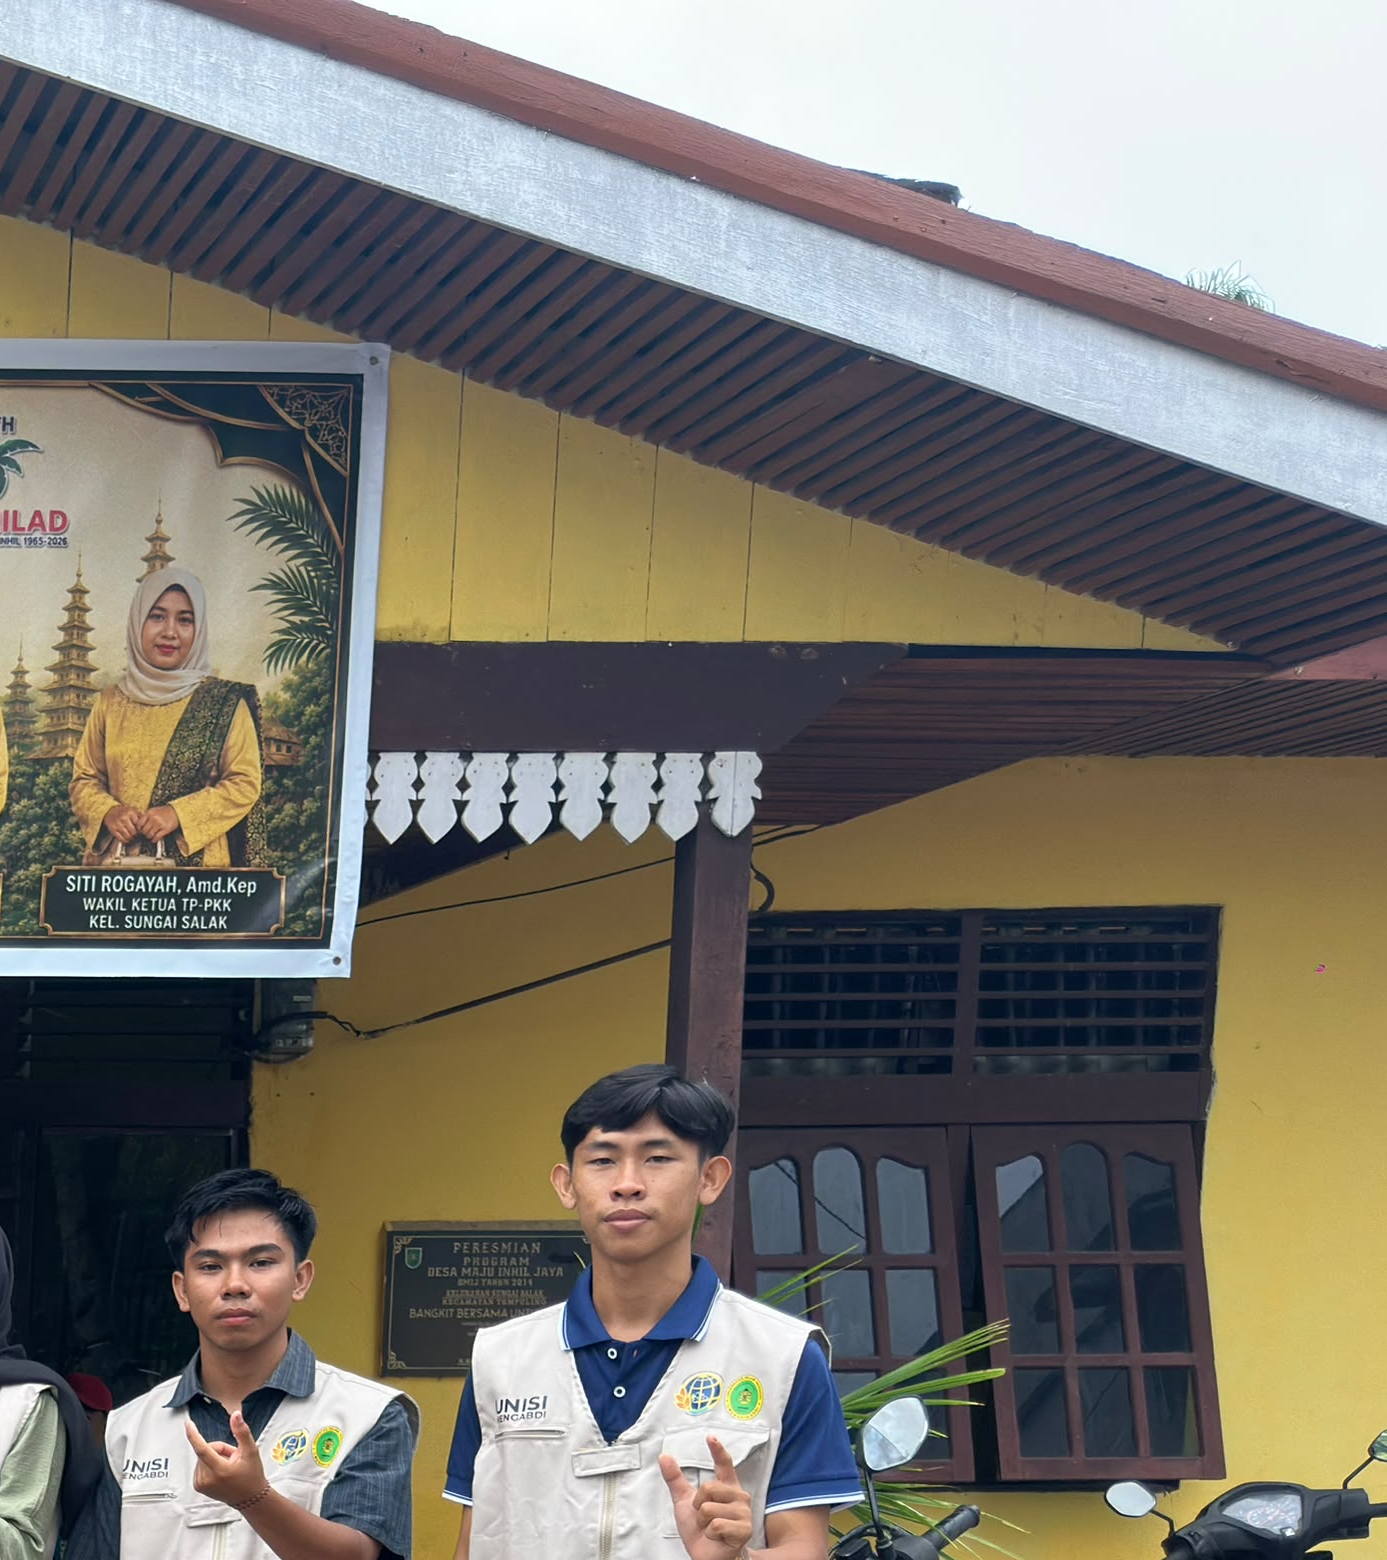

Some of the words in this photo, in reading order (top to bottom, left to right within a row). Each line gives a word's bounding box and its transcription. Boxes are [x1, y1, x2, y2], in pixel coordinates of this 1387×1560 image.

[23, 536, 68, 546] 1965-2026
[66, 874, 96, 893] SITI
[101, 875, 182, 896] ROGAYAH,
[186, 876, 257, 897] Amd.Kep
[83, 897, 127, 911] WAKIL
[131, 898, 177, 912] KETUA
[181, 899, 232, 912] TP-PKK
[89, 915, 120, 929] KEL.
[124, 915, 177, 929] SUNGAI
[181, 916, 227, 929] SALAK
[453, 1242, 542, 1254] PERESMIAN
[463, 1256, 530, 1266] PROGRAM
[428, 1266, 458, 1277] DESA
[461, 1266, 495, 1277] MAJU
[498, 1266, 531, 1277] INHIL
[533, 1266, 564, 1277] JAYA
[409, 1308, 455, 1319] BANGKIT
[456, 1308, 508, 1319] BERSAMA
[494, 1394, 548, 1414] UNISI
[497, 1410, 547, 1423] ENGABDI
[122, 1470, 169, 1480] ENGABDI
